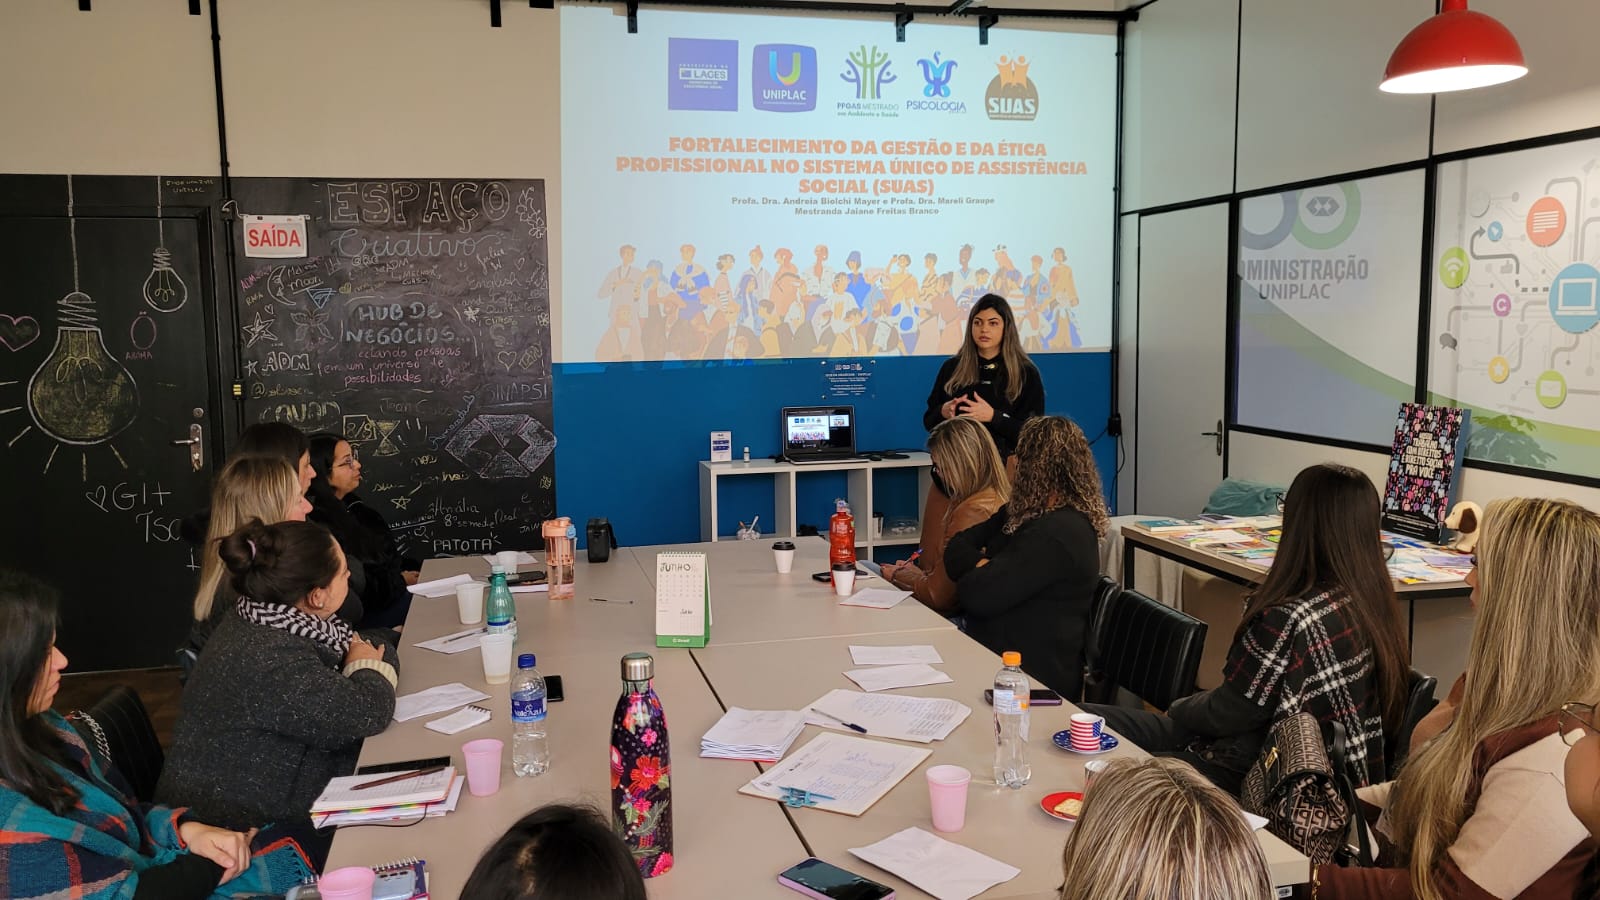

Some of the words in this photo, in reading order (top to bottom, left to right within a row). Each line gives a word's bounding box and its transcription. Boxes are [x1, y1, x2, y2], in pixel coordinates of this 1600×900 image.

[694, 70, 726, 79] LAGES
[763, 90, 807, 100] UNIPLAC
[862, 103, 900, 111] MESTRADO
[906, 100, 967, 112] PSICOLOGIA
[988, 96, 1036, 114] SUAS
[668, 136, 848, 154] FORTALECIMENTO
[850, 140, 878, 155] DA
[881, 138, 953, 156] GESTÃO
[956, 142, 967, 155] E
[970, 142, 996, 156] DA
[998, 139, 1048, 157] ÉTICA
[615, 156, 767, 173] PROFISSIONAL
[770, 159, 800, 174] NO
[803, 159, 887, 174] SISTEMA
[889, 157, 949, 175] ÚNICO
[951, 161, 975, 175] DE
[978, 159, 1088, 176] ASSISTÊNCIA
[798, 179, 868, 194] SOCIAL
[873, 179, 935, 196] (SUAS)
[327, 182, 510, 234] ESPAÇO
[732, 197, 759, 206] Profa.
[762, 197, 780, 206] Dra.
[783, 197, 817, 207] Andreia
[854, 198, 881, 208] Mayer
[891, 197, 916, 207] Profa.
[919, 197, 936, 206] Dra.
[795, 207, 844, 217] Mestranda
[878, 207, 907, 217] Freitas
[910, 207, 941, 216] Branco
[248, 225, 301, 248] SAÍDA
[331, 228, 478, 257] Criativo
[1259, 284, 1331, 300] UNIPLAC
[359, 303, 404, 321] HUB
[409, 302, 443, 320] DE
[262, 350, 310, 372] ADM
[373, 361, 420, 371] universo
[344, 369, 423, 388] possibilidades
[433, 538, 493, 553] PATOTA
